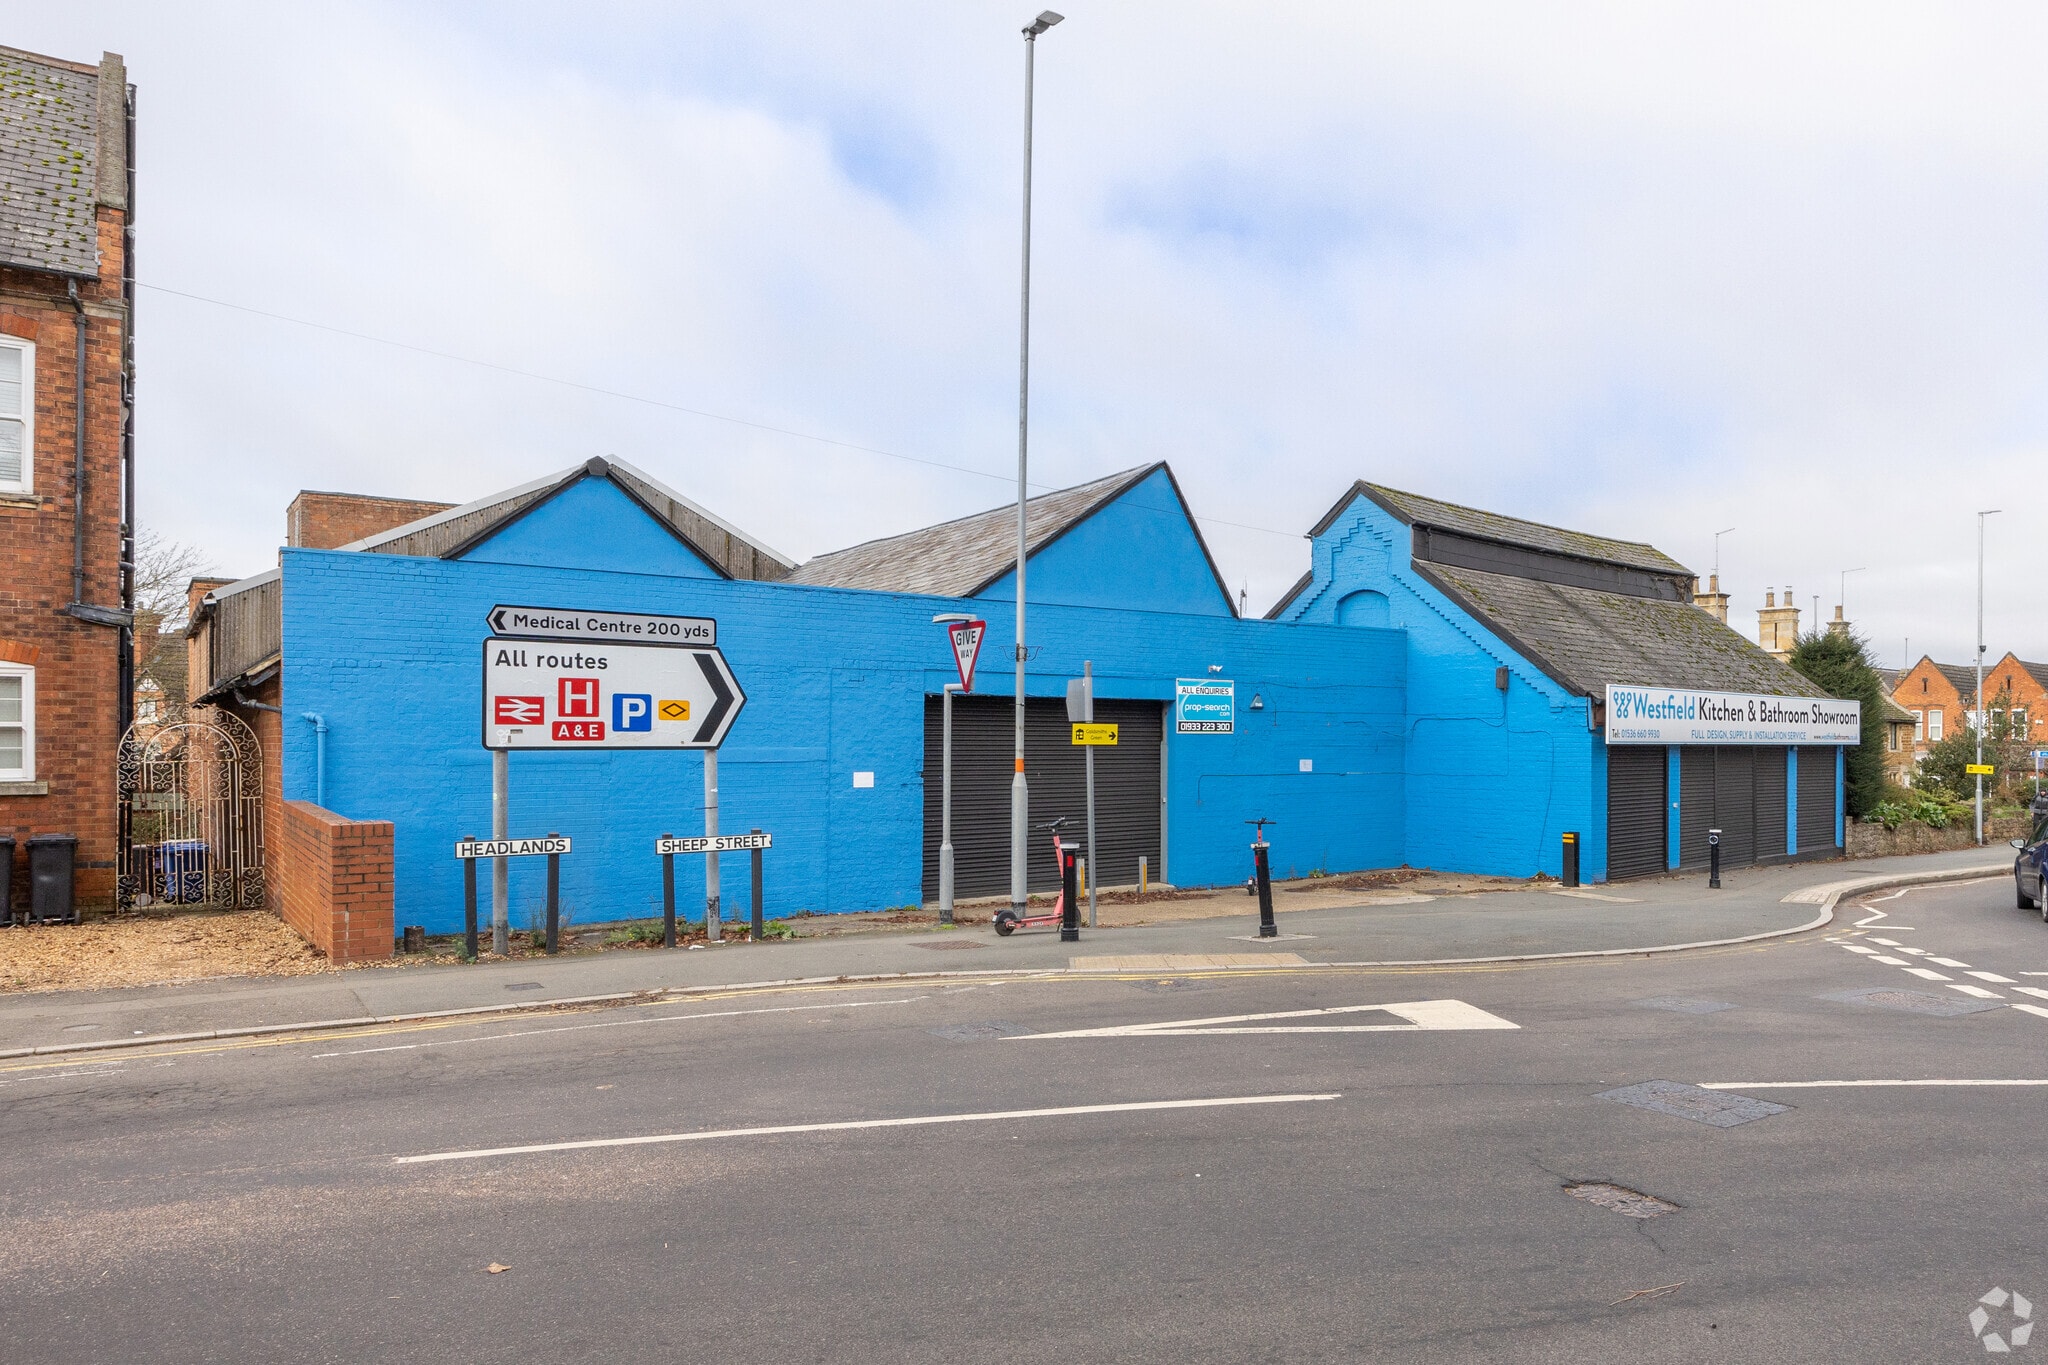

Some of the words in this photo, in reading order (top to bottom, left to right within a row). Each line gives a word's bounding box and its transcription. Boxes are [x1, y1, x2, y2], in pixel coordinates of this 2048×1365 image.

[514, 614, 580, 630] Medical
[587, 618, 642, 634] Centre
[647, 622, 680, 635] 200
[684, 625, 709, 639] yds
[956, 630, 976, 646] GIVE
[495, 649, 527, 667] All
[536, 652, 608, 670] routes
[961, 649, 973, 659] WAY
[564, 681, 593, 714] H
[1196, 687, 1229, 695] ENQUIRIES
[622, 698, 647, 728] P
[1184, 704, 1230, 712] prop-search
[1633, 692, 1695, 720] Westfield
[1699, 696, 1744, 721] Kitchen
[1748, 700, 1756, 722] &
[1760, 701, 1809, 724] Bathroom
[1812, 703, 1858, 725] Showroom
[1180, 722, 1200, 731] 01933
[1202, 722, 1215, 731] 223
[1216, 722, 1230, 731] 300
[1691, 730, 1704, 739] FULL
[1730, 730, 1748, 740] SUPPLY
[1749, 731, 1752, 740] &
[1754, 731, 1787, 740] INSTALLATION
[1788, 731, 1806, 740] SERVICE
[461, 839, 566, 857] HEADLANDS
[662, 839, 708, 852] SHEEP
[716, 835, 767, 849] STREET
